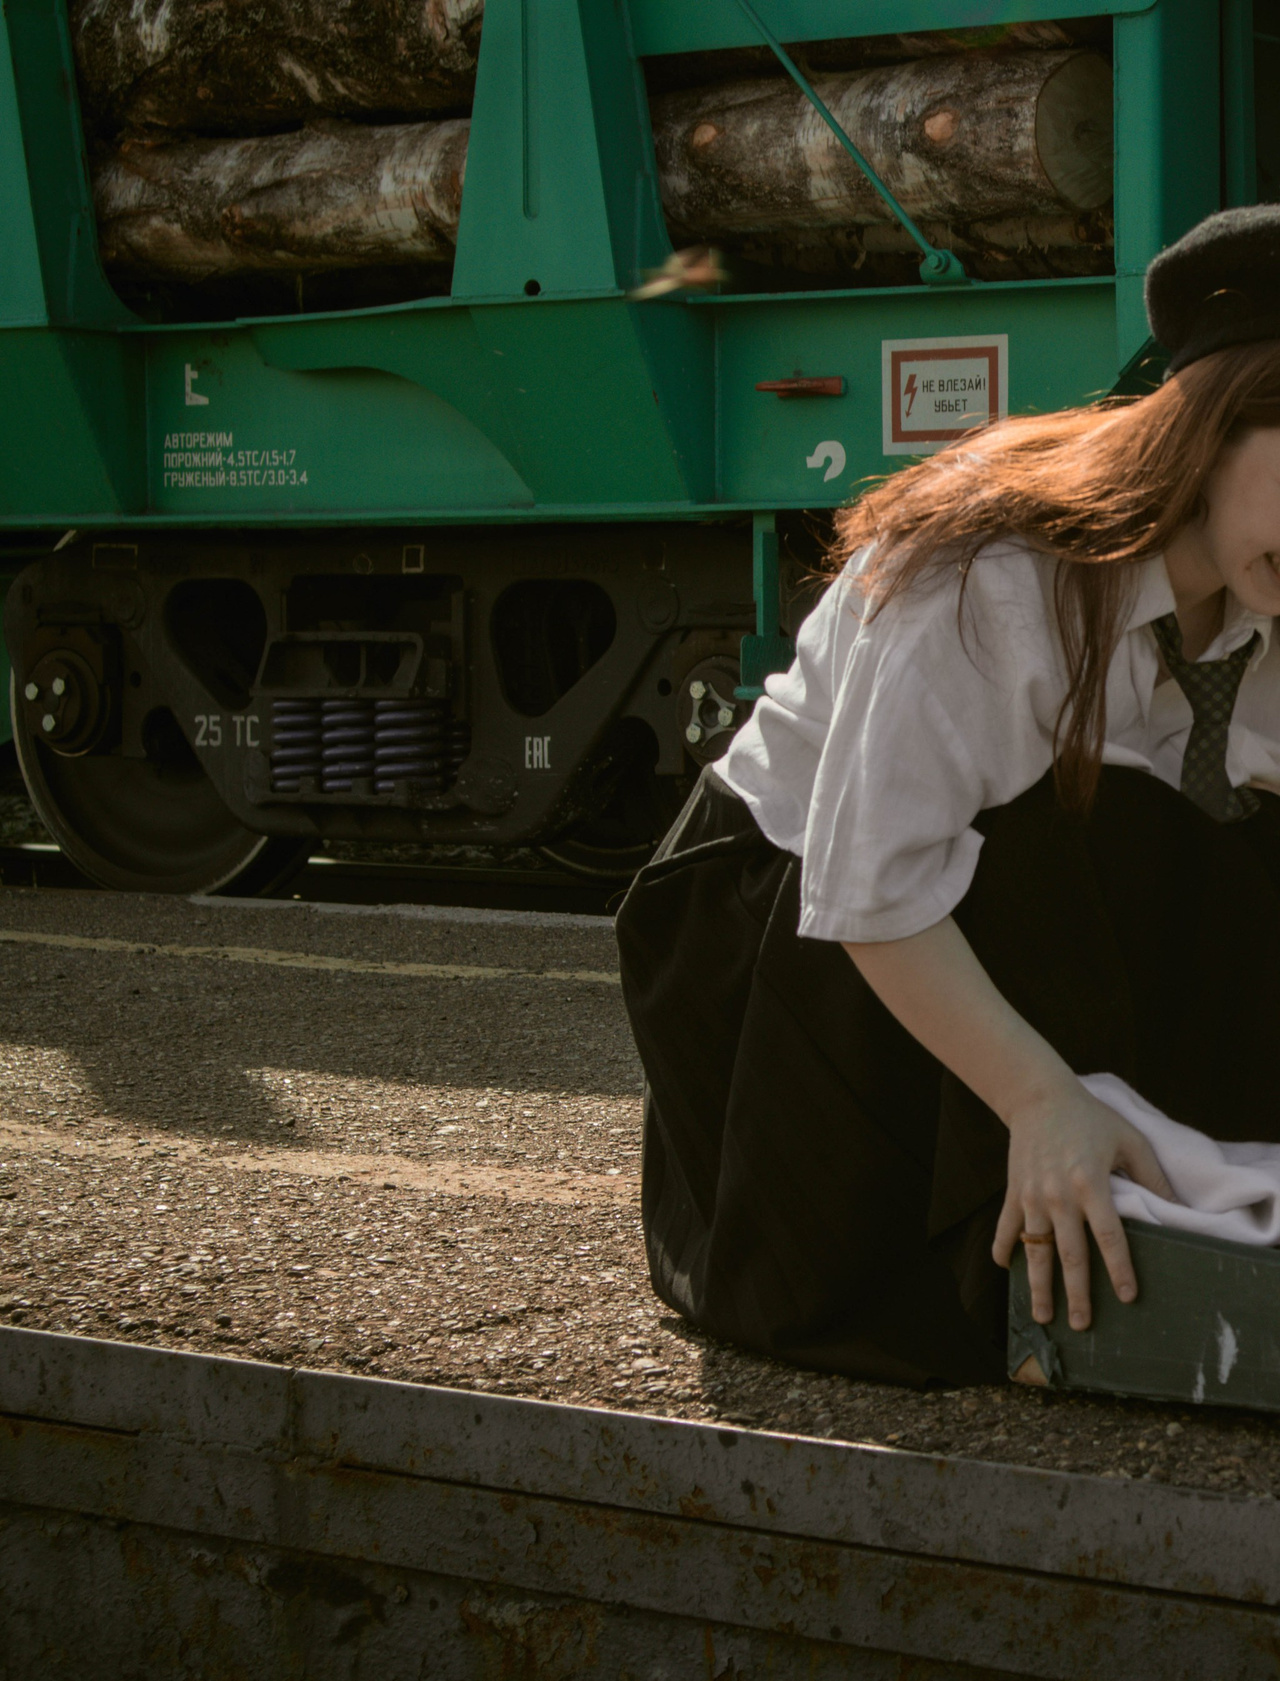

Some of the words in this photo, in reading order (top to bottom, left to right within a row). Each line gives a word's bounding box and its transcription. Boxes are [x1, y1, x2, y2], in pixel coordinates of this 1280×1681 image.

[922, 380, 935, 393] НЕ
[938, 374, 986, 392] ВЛЕЗАЙ!
[934, 399, 967, 413] УБЬЕТ
[164, 432, 233, 449] АВТОРЕЖИМ
[194, 715, 222, 747] 25
[232, 715, 260, 747] ТС
